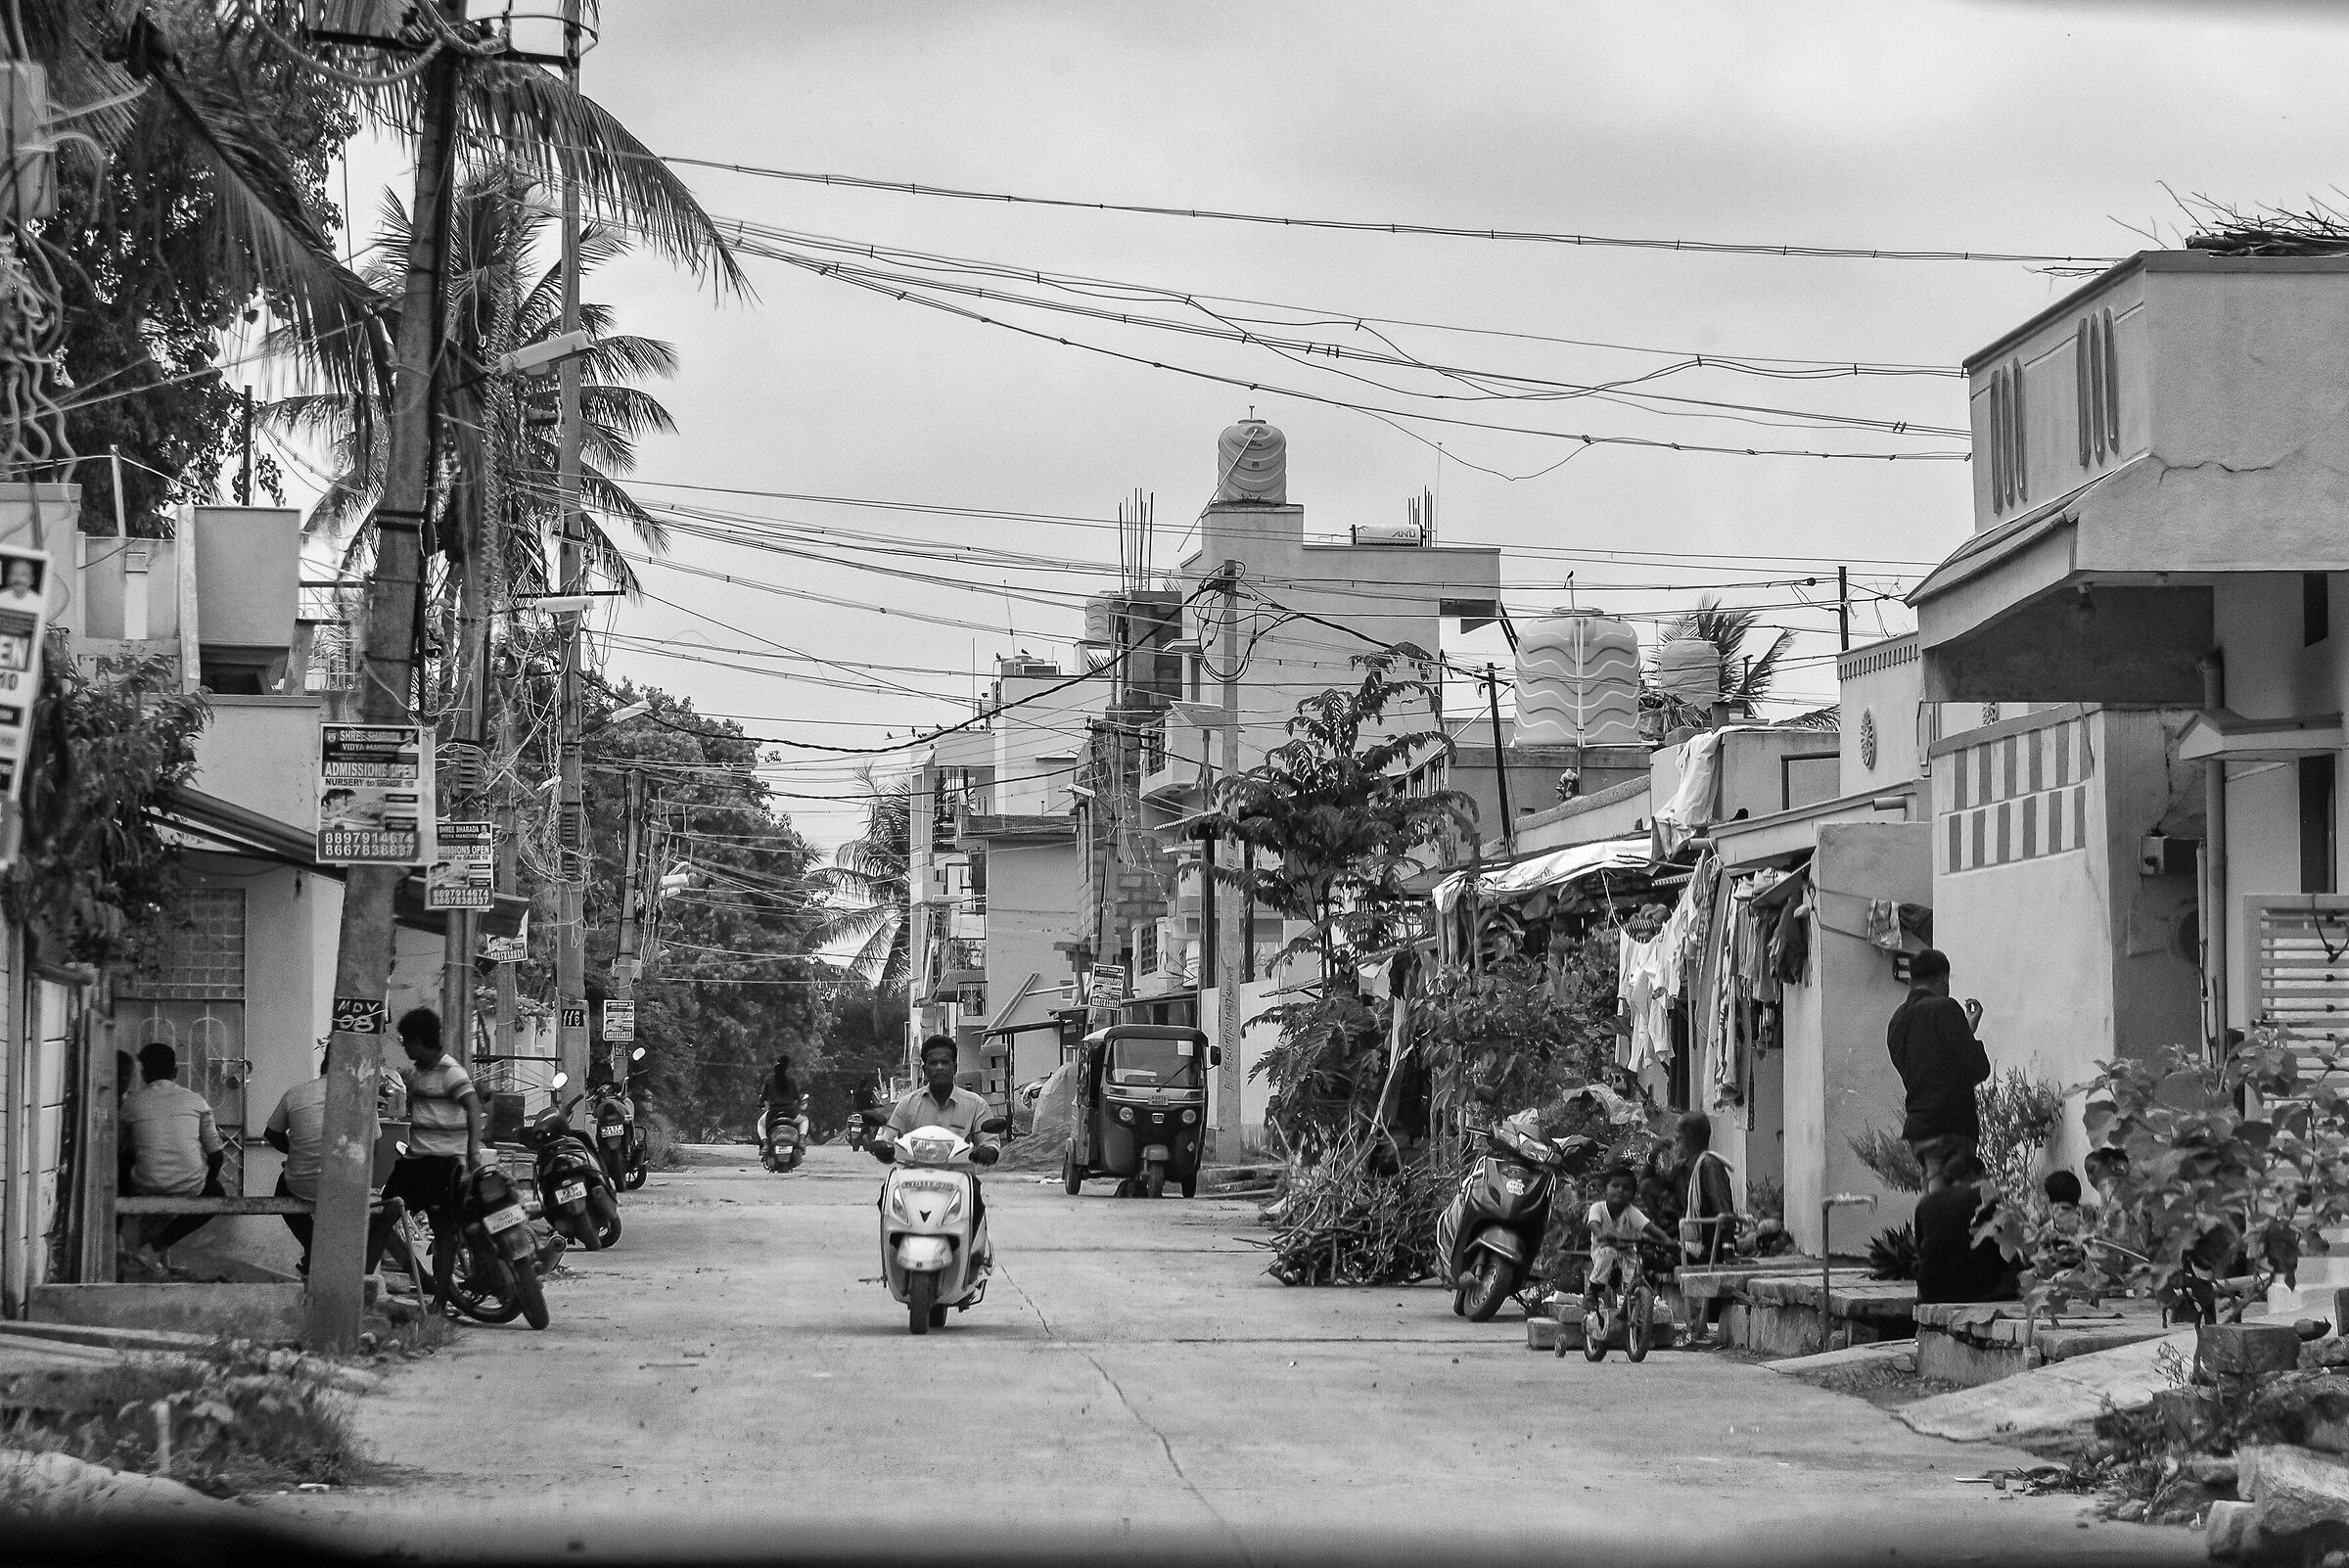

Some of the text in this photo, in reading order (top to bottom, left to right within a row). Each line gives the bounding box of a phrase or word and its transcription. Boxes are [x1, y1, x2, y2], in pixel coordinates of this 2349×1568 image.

[340, 730, 366, 742] SHREE
[324, 761, 417, 778] ADMISSIONS OPEN
[325, 778, 364, 787] NURSERY
[325, 832, 415, 844] 8897914674
[471, 845, 490, 854] OPEN
